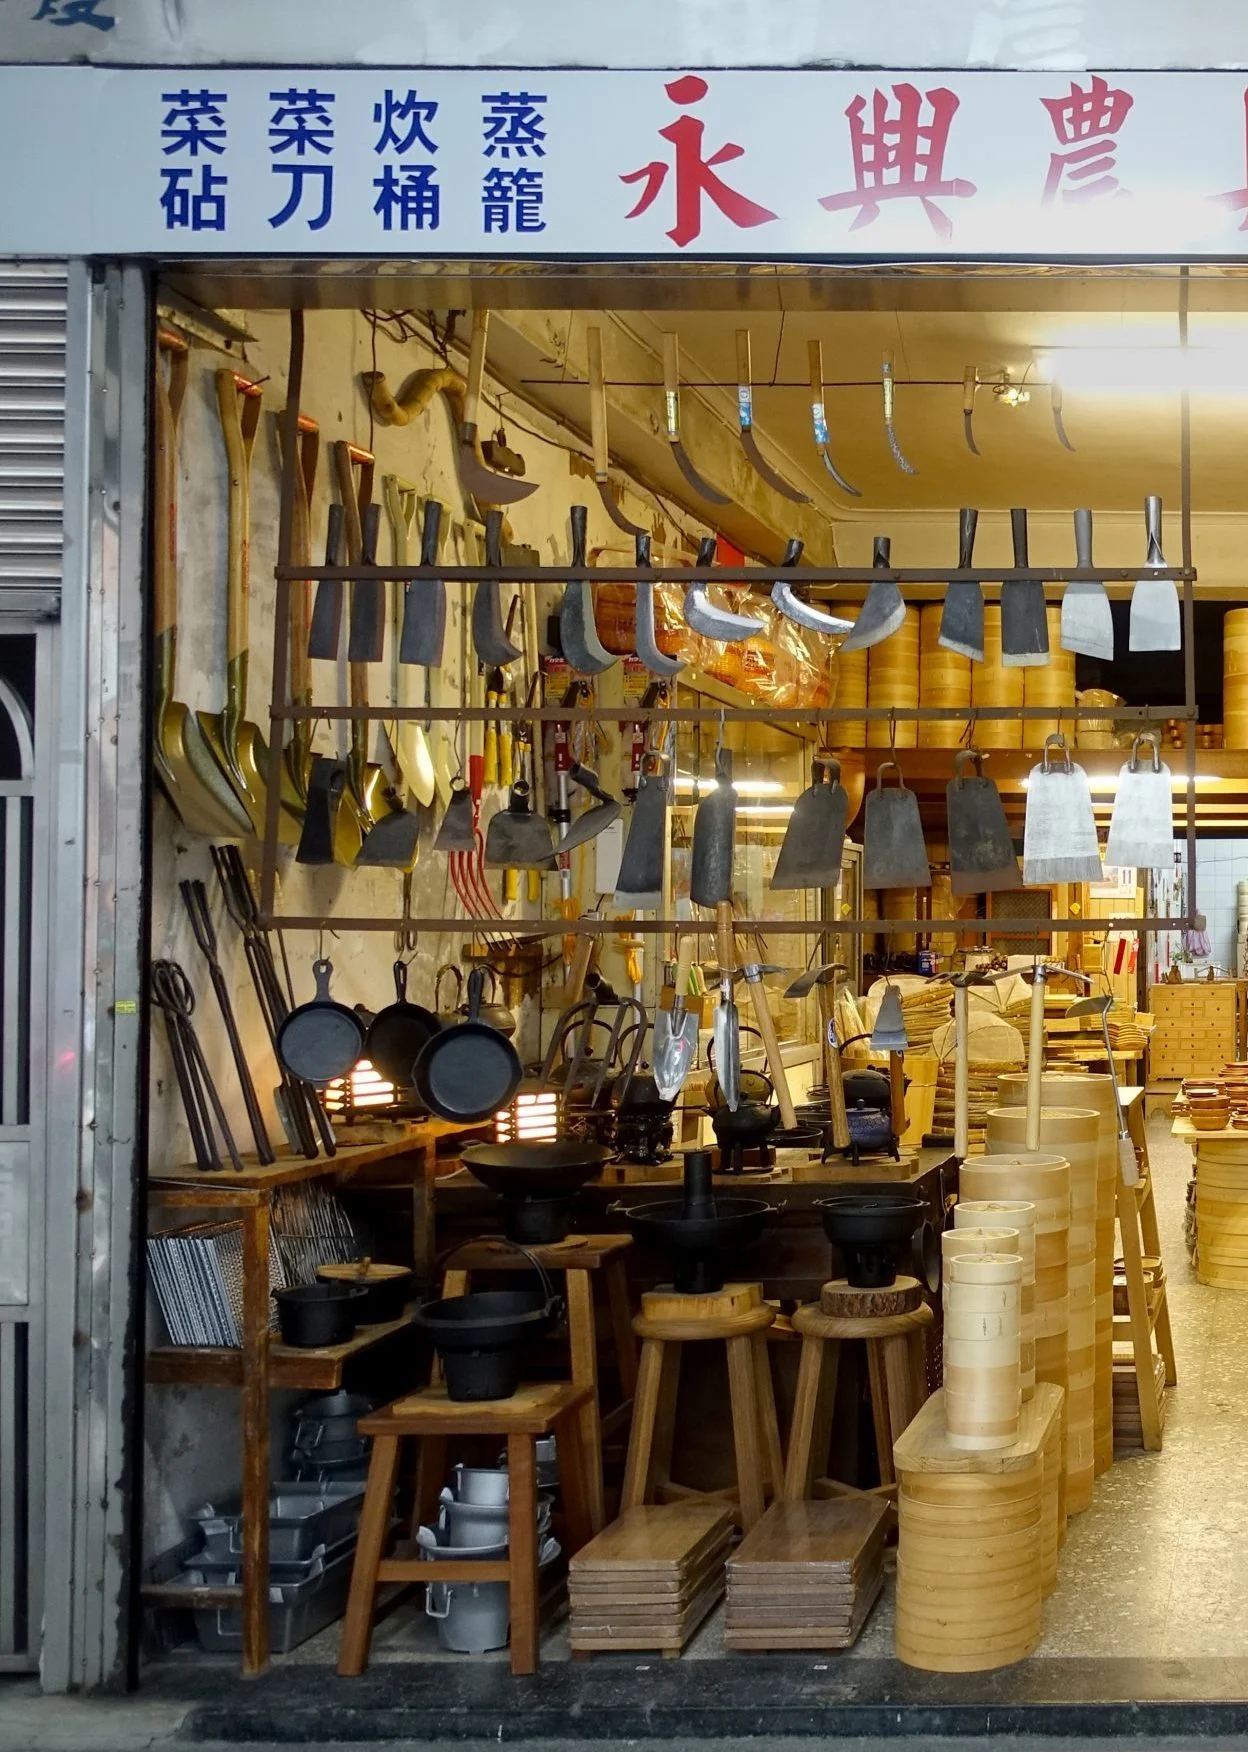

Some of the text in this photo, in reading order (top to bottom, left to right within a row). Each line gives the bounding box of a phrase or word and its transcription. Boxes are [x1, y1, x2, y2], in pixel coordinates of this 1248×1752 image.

[160, 88, 228, 231] 菜砧
[268, 88, 336, 230] 菜刀
[372, 88, 441, 231] 炊桶
[481, 90, 548, 233] 蒸籠
